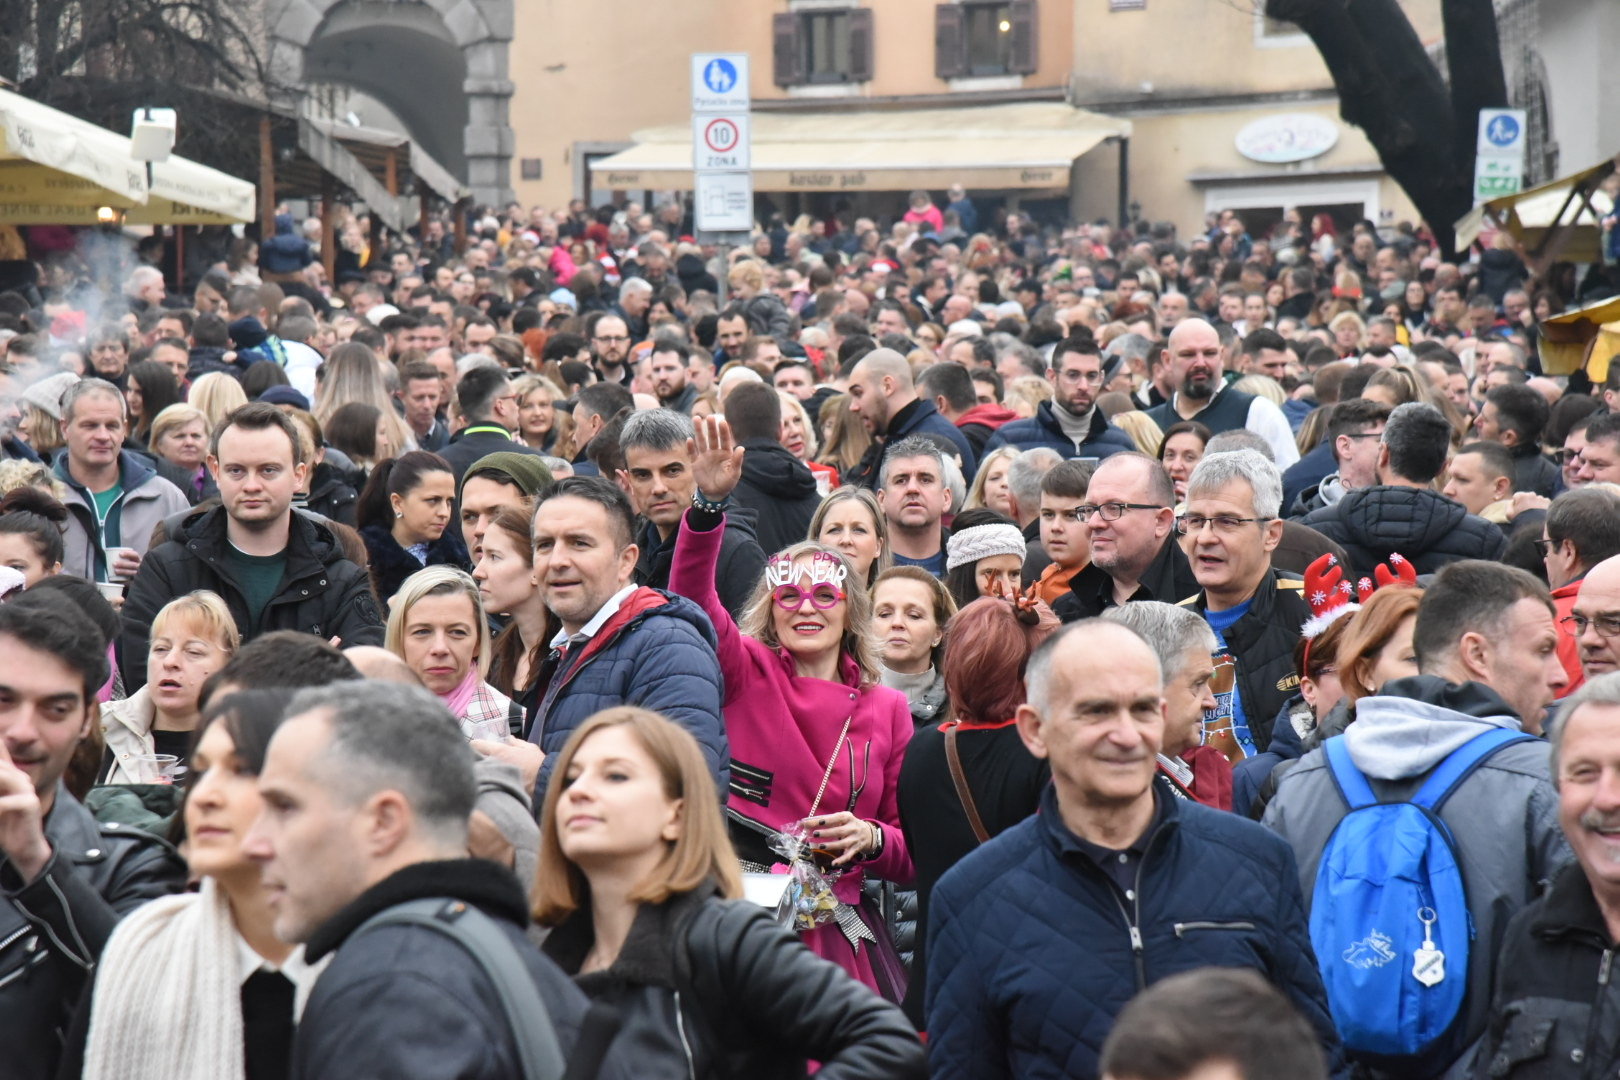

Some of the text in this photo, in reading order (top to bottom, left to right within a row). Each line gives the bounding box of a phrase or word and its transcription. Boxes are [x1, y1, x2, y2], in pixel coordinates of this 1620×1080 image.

[714, 127, 730, 145] 10
[707, 156, 737, 167] ZONA
[765, 559, 847, 590] NEW YEAR
